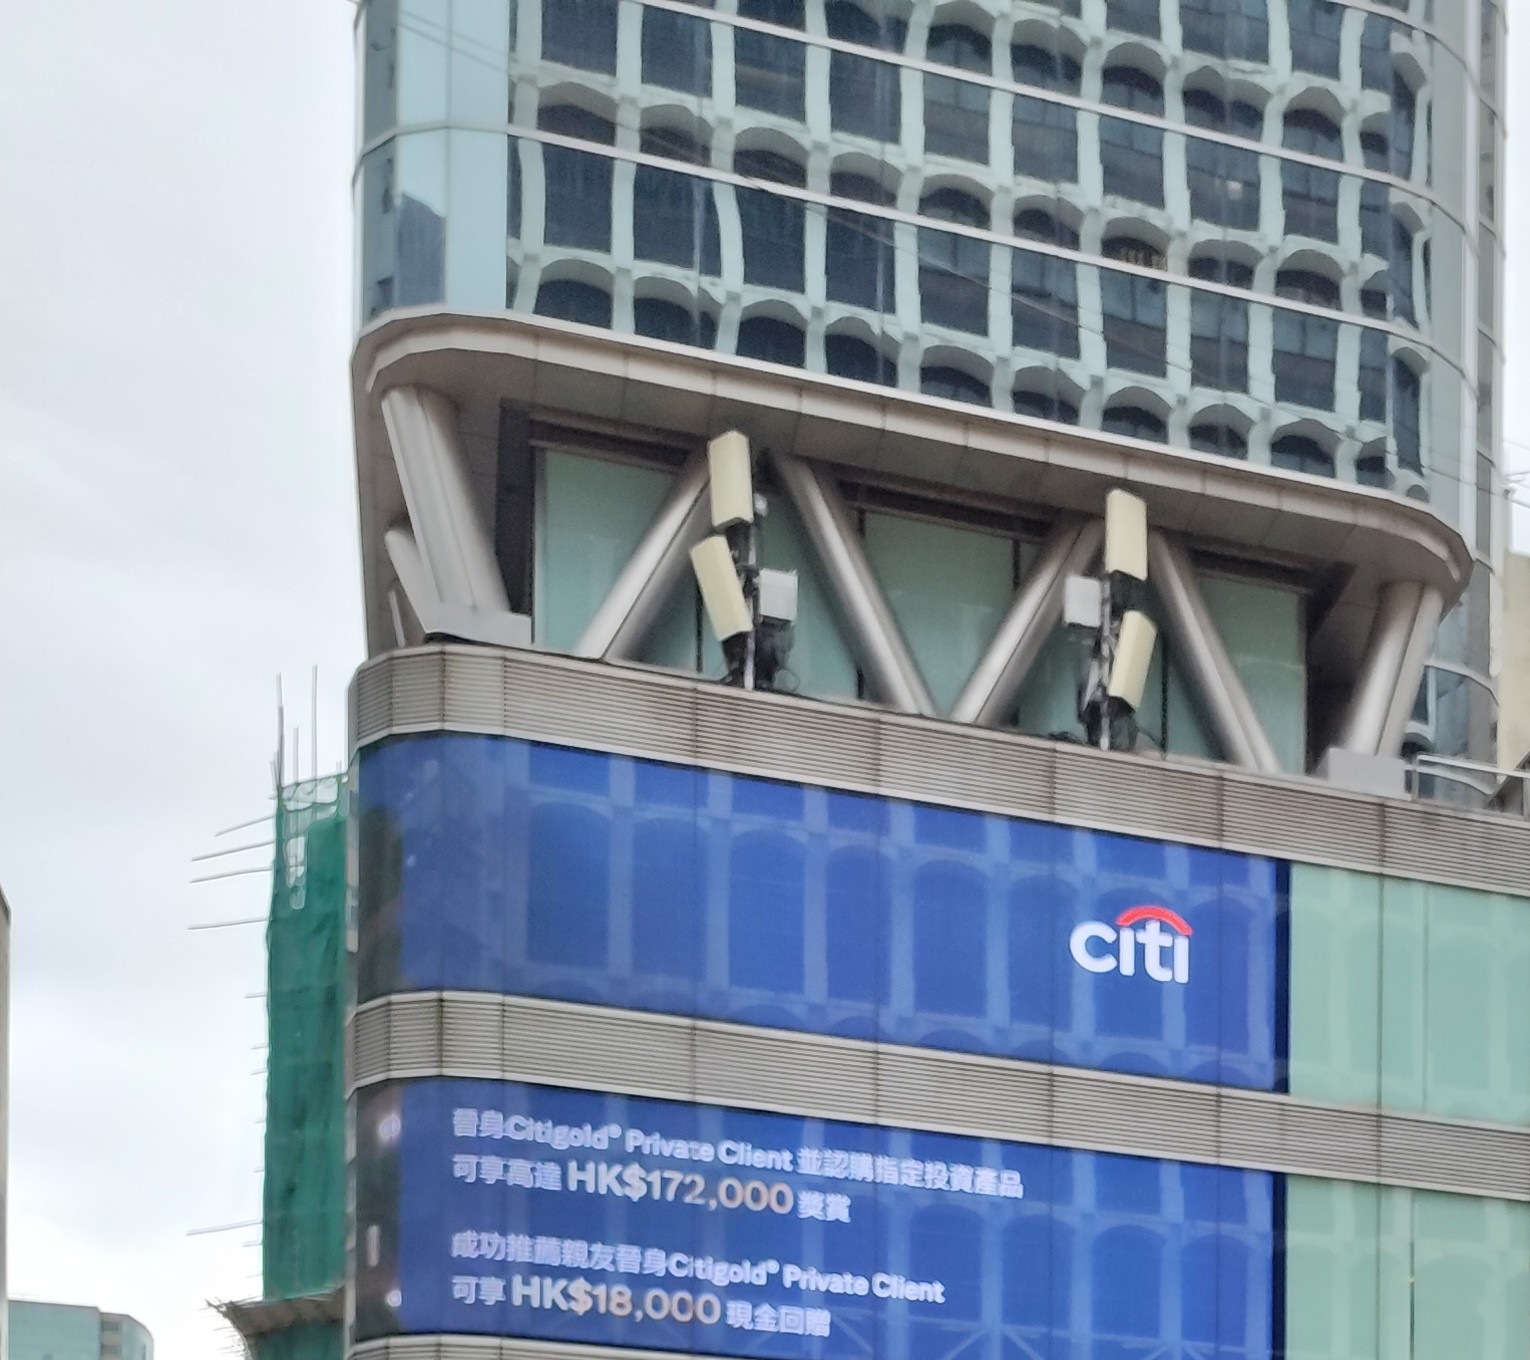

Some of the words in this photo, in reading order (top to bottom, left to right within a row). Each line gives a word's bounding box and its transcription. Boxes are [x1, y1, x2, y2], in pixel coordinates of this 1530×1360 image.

[1069, 906, 1192, 984] citi
[625, 1128, 715, 1162] Private
[717, 1139, 793, 1172] Client
[567, 1159, 794, 1215] HK$172,000
[451, 1275, 506, 1305] 可享
[512, 1273, 722, 1325] HK$18,000
[782, 1264, 869, 1296] Private
[871, 1272, 946, 1304] Client
